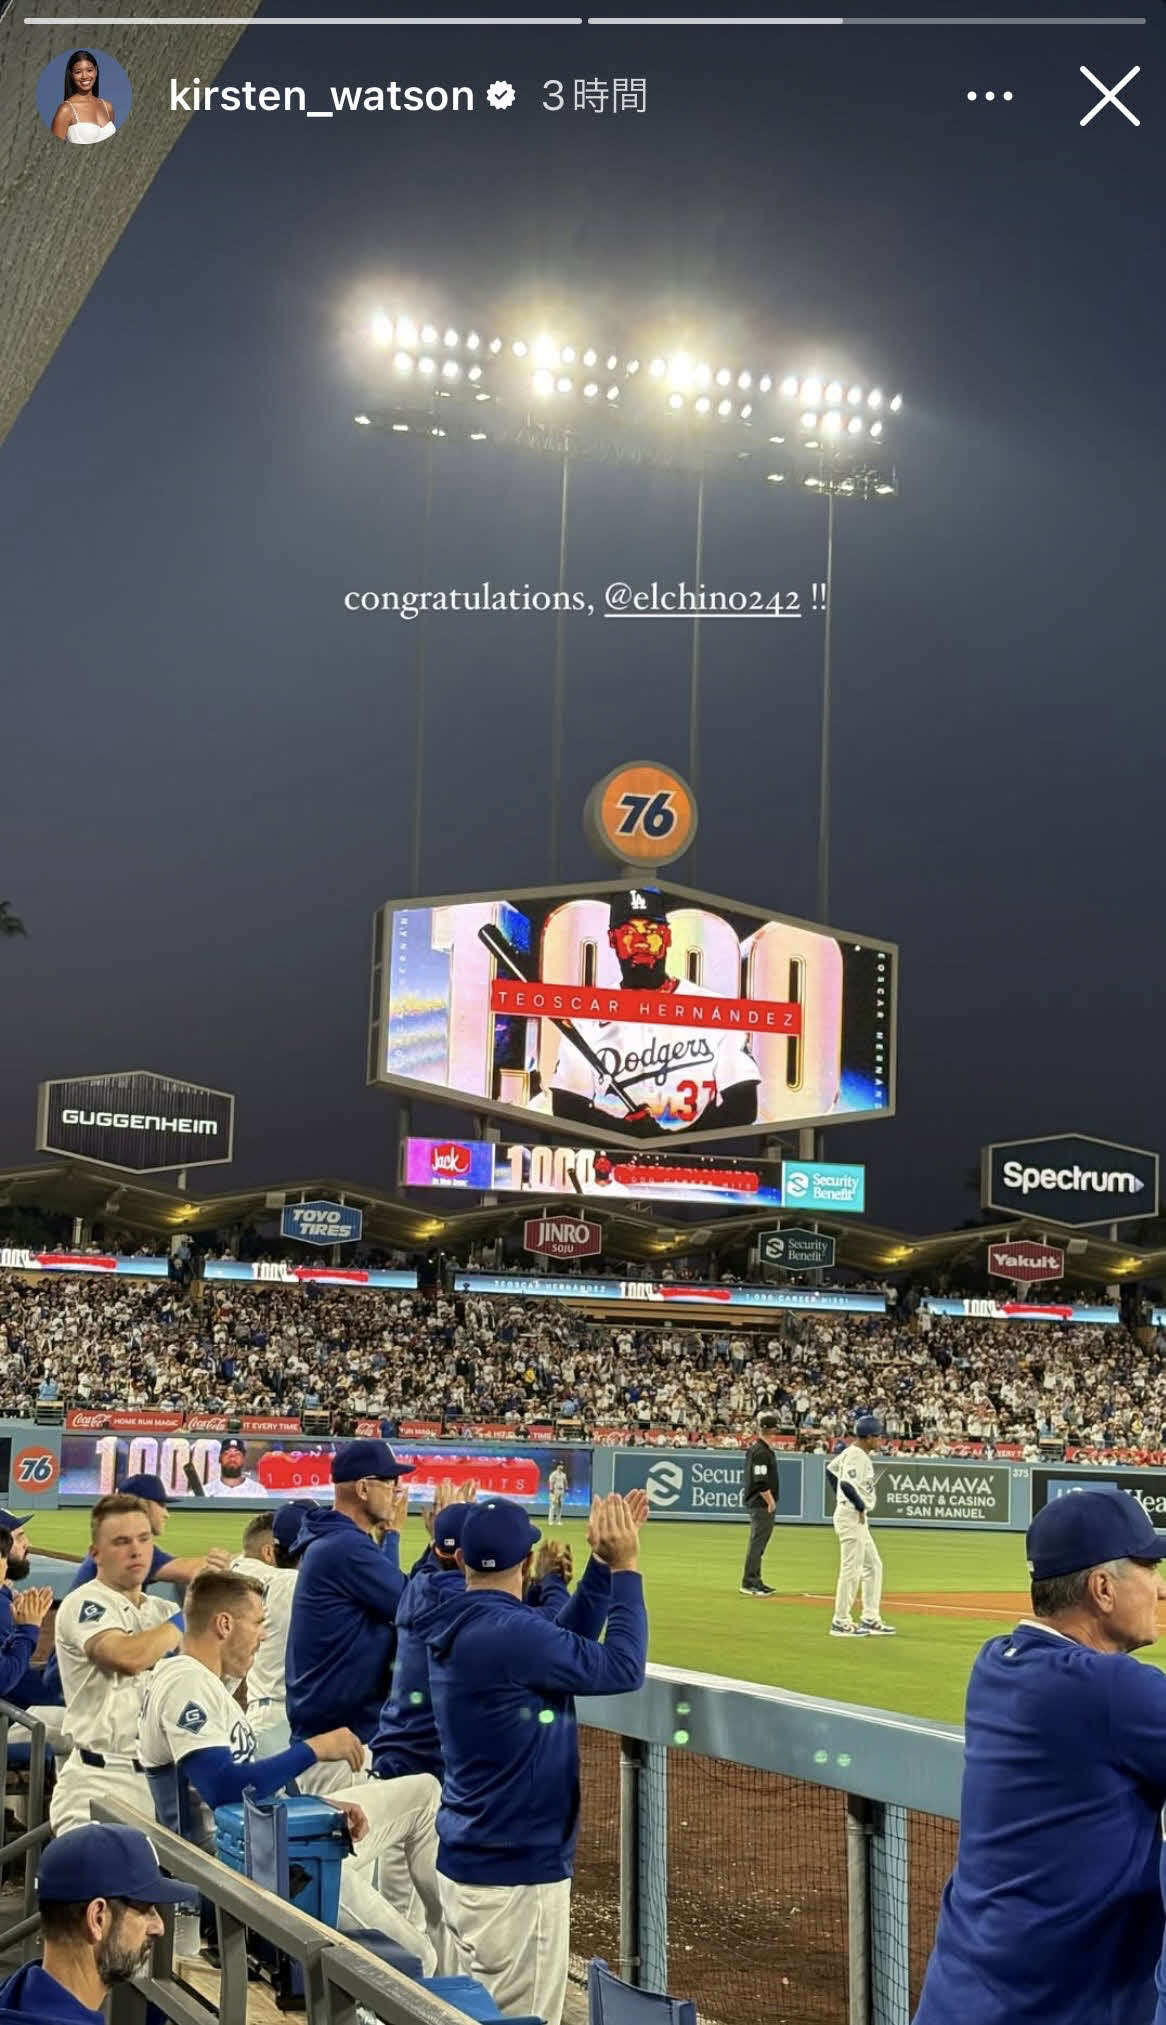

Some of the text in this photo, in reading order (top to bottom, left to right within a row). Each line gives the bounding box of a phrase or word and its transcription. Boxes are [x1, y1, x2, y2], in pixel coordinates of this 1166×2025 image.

[615, 789, 678, 840] 76
[498, 991, 793, 1027] TEOSCAR HERNÁNDEZ
[597, 1036, 710, 1087] Dodgers
[62, 1109, 218, 1135] GUGGENHEIM
[432, 1146, 469, 1173] Jack
[813, 1173, 859, 1193] Security
[1003, 1161, 1136, 1194] Spectrum
[813, 1187, 854, 1201] Benefit
[293, 1209, 341, 1223] TOYO
[300, 1223, 352, 1238] TIRES
[536, 1222, 590, 1248] JINRO
[551, 1243, 574, 1254] SOJU
[787, 1238, 829, 1252] Security
[787, 1249, 822, 1261] Benefit
[993, 1253, 1061, 1269] Yakult
[280, 1423, 299, 1432] TIME
[19, 1455, 53, 1483] 76
[691, 1463, 745, 1484] Secur
[1011, 1468, 1030, 1478] 375
[691, 1486, 746, 1508] Benef
[886, 1493, 997, 1507] RESORT & CASINO
[905, 1505, 932, 1517] SAN
[934, 1506, 986, 1519] MANUEL
